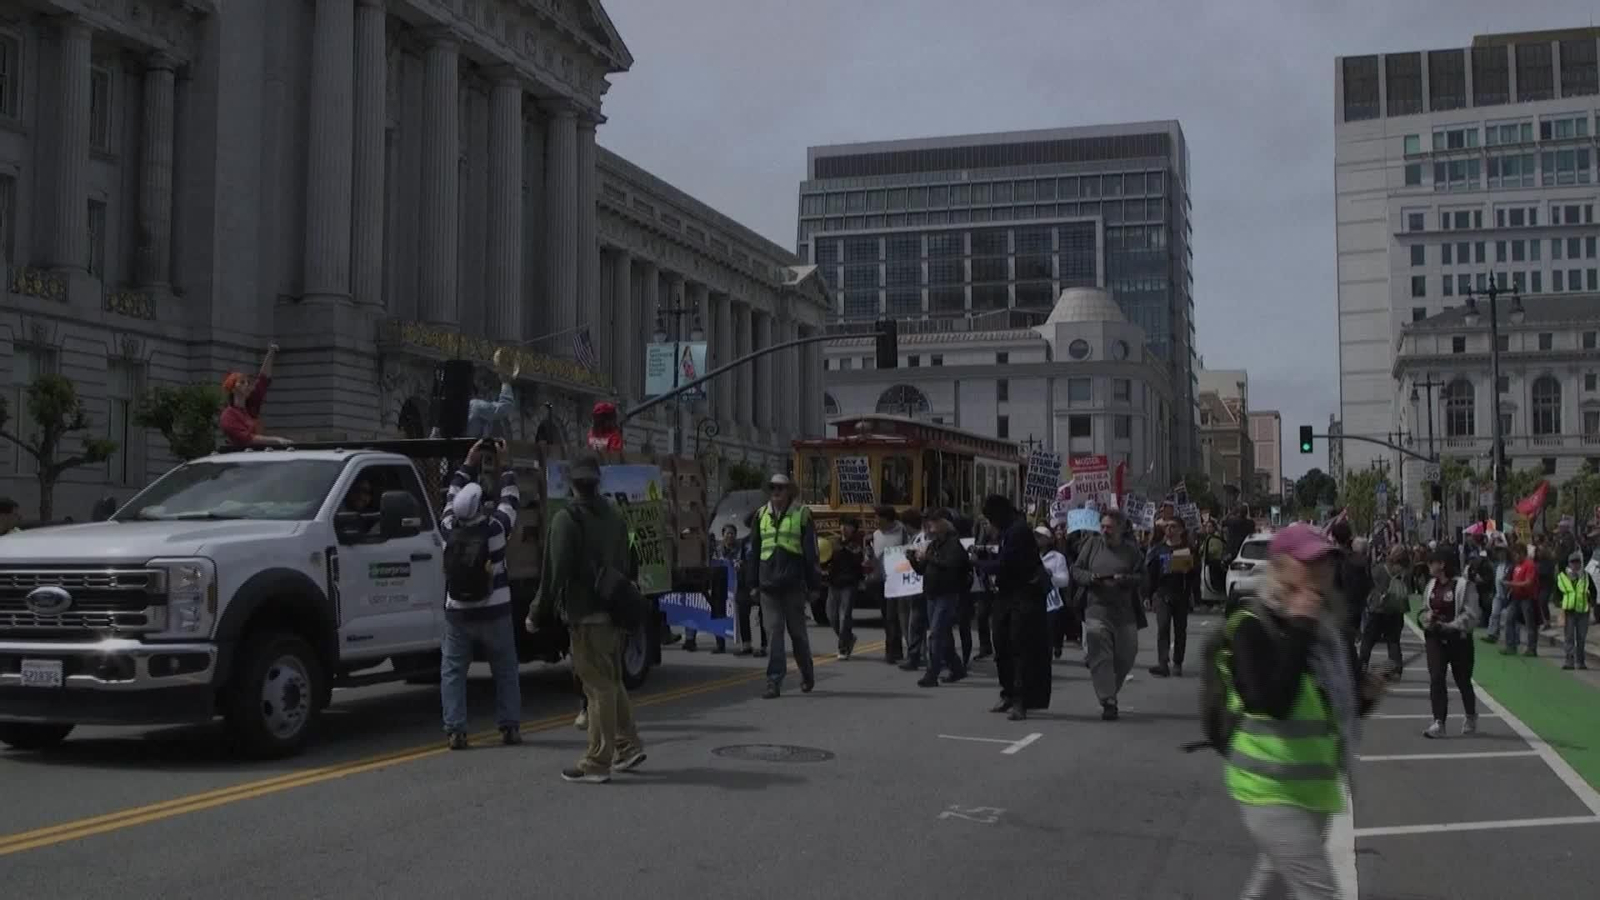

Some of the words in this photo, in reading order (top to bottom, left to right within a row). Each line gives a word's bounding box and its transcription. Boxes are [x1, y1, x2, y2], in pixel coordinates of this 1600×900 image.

[1039, 467, 1060, 477] TRUMP
[1027, 473, 1058, 487] GENERAL
[840, 481, 871, 492] GENERAL
[1075, 481, 1110, 494] HUELGA
